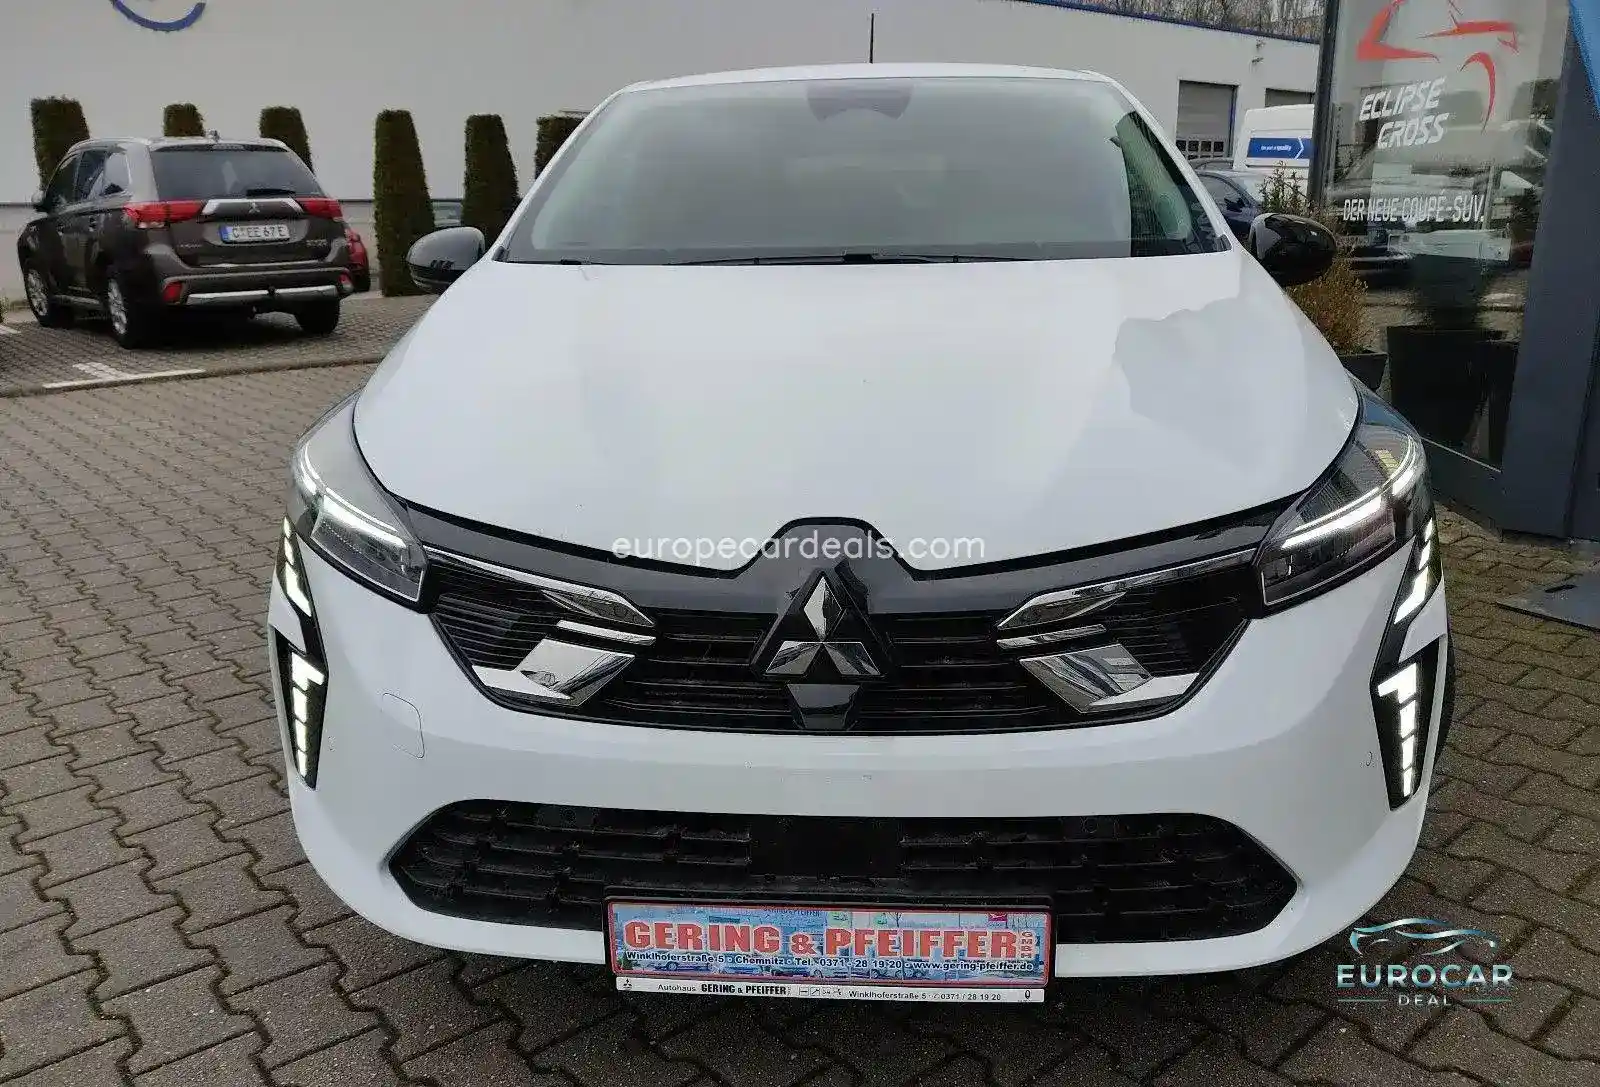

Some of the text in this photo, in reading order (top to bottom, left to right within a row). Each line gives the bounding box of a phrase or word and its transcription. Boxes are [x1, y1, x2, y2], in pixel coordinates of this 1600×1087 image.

[1359, 75, 1447, 122] ECLIPSE
[1378, 112, 1450, 149] CROSS
[1343, 198, 1365, 222] DER
[1367, 198, 1399, 222] NEUE
[624, 921, 780, 953] GERING
[791, 933, 816, 955] &
[825, 927, 1017, 959] PFEIFFER
[627, 951, 714, 963] Winklhoferstraße
[717, 955, 725, 963] 5
[735, 955, 784, 966] Chemnitz
[795, 957, 814, 967] Tel.
[819, 958, 845, 967] 0371
[855, 959, 868, 968] 28
[873, 960, 885, 969] 19
[888, 960, 902, 969] 20
[913, 961, 1033, 972] www.gering-pfeiffer.de
[657, 984, 697, 992] Autohaus
[701, 983, 736, 994] GERING
[745, 985, 787, 996] PFEIFFER
[848, 990, 920, 1000] Winklhoferstraße
[921, 992, 927, 1000] 5
[967, 993, 977, 1001] 28
[980, 993, 989, 1001] 19
